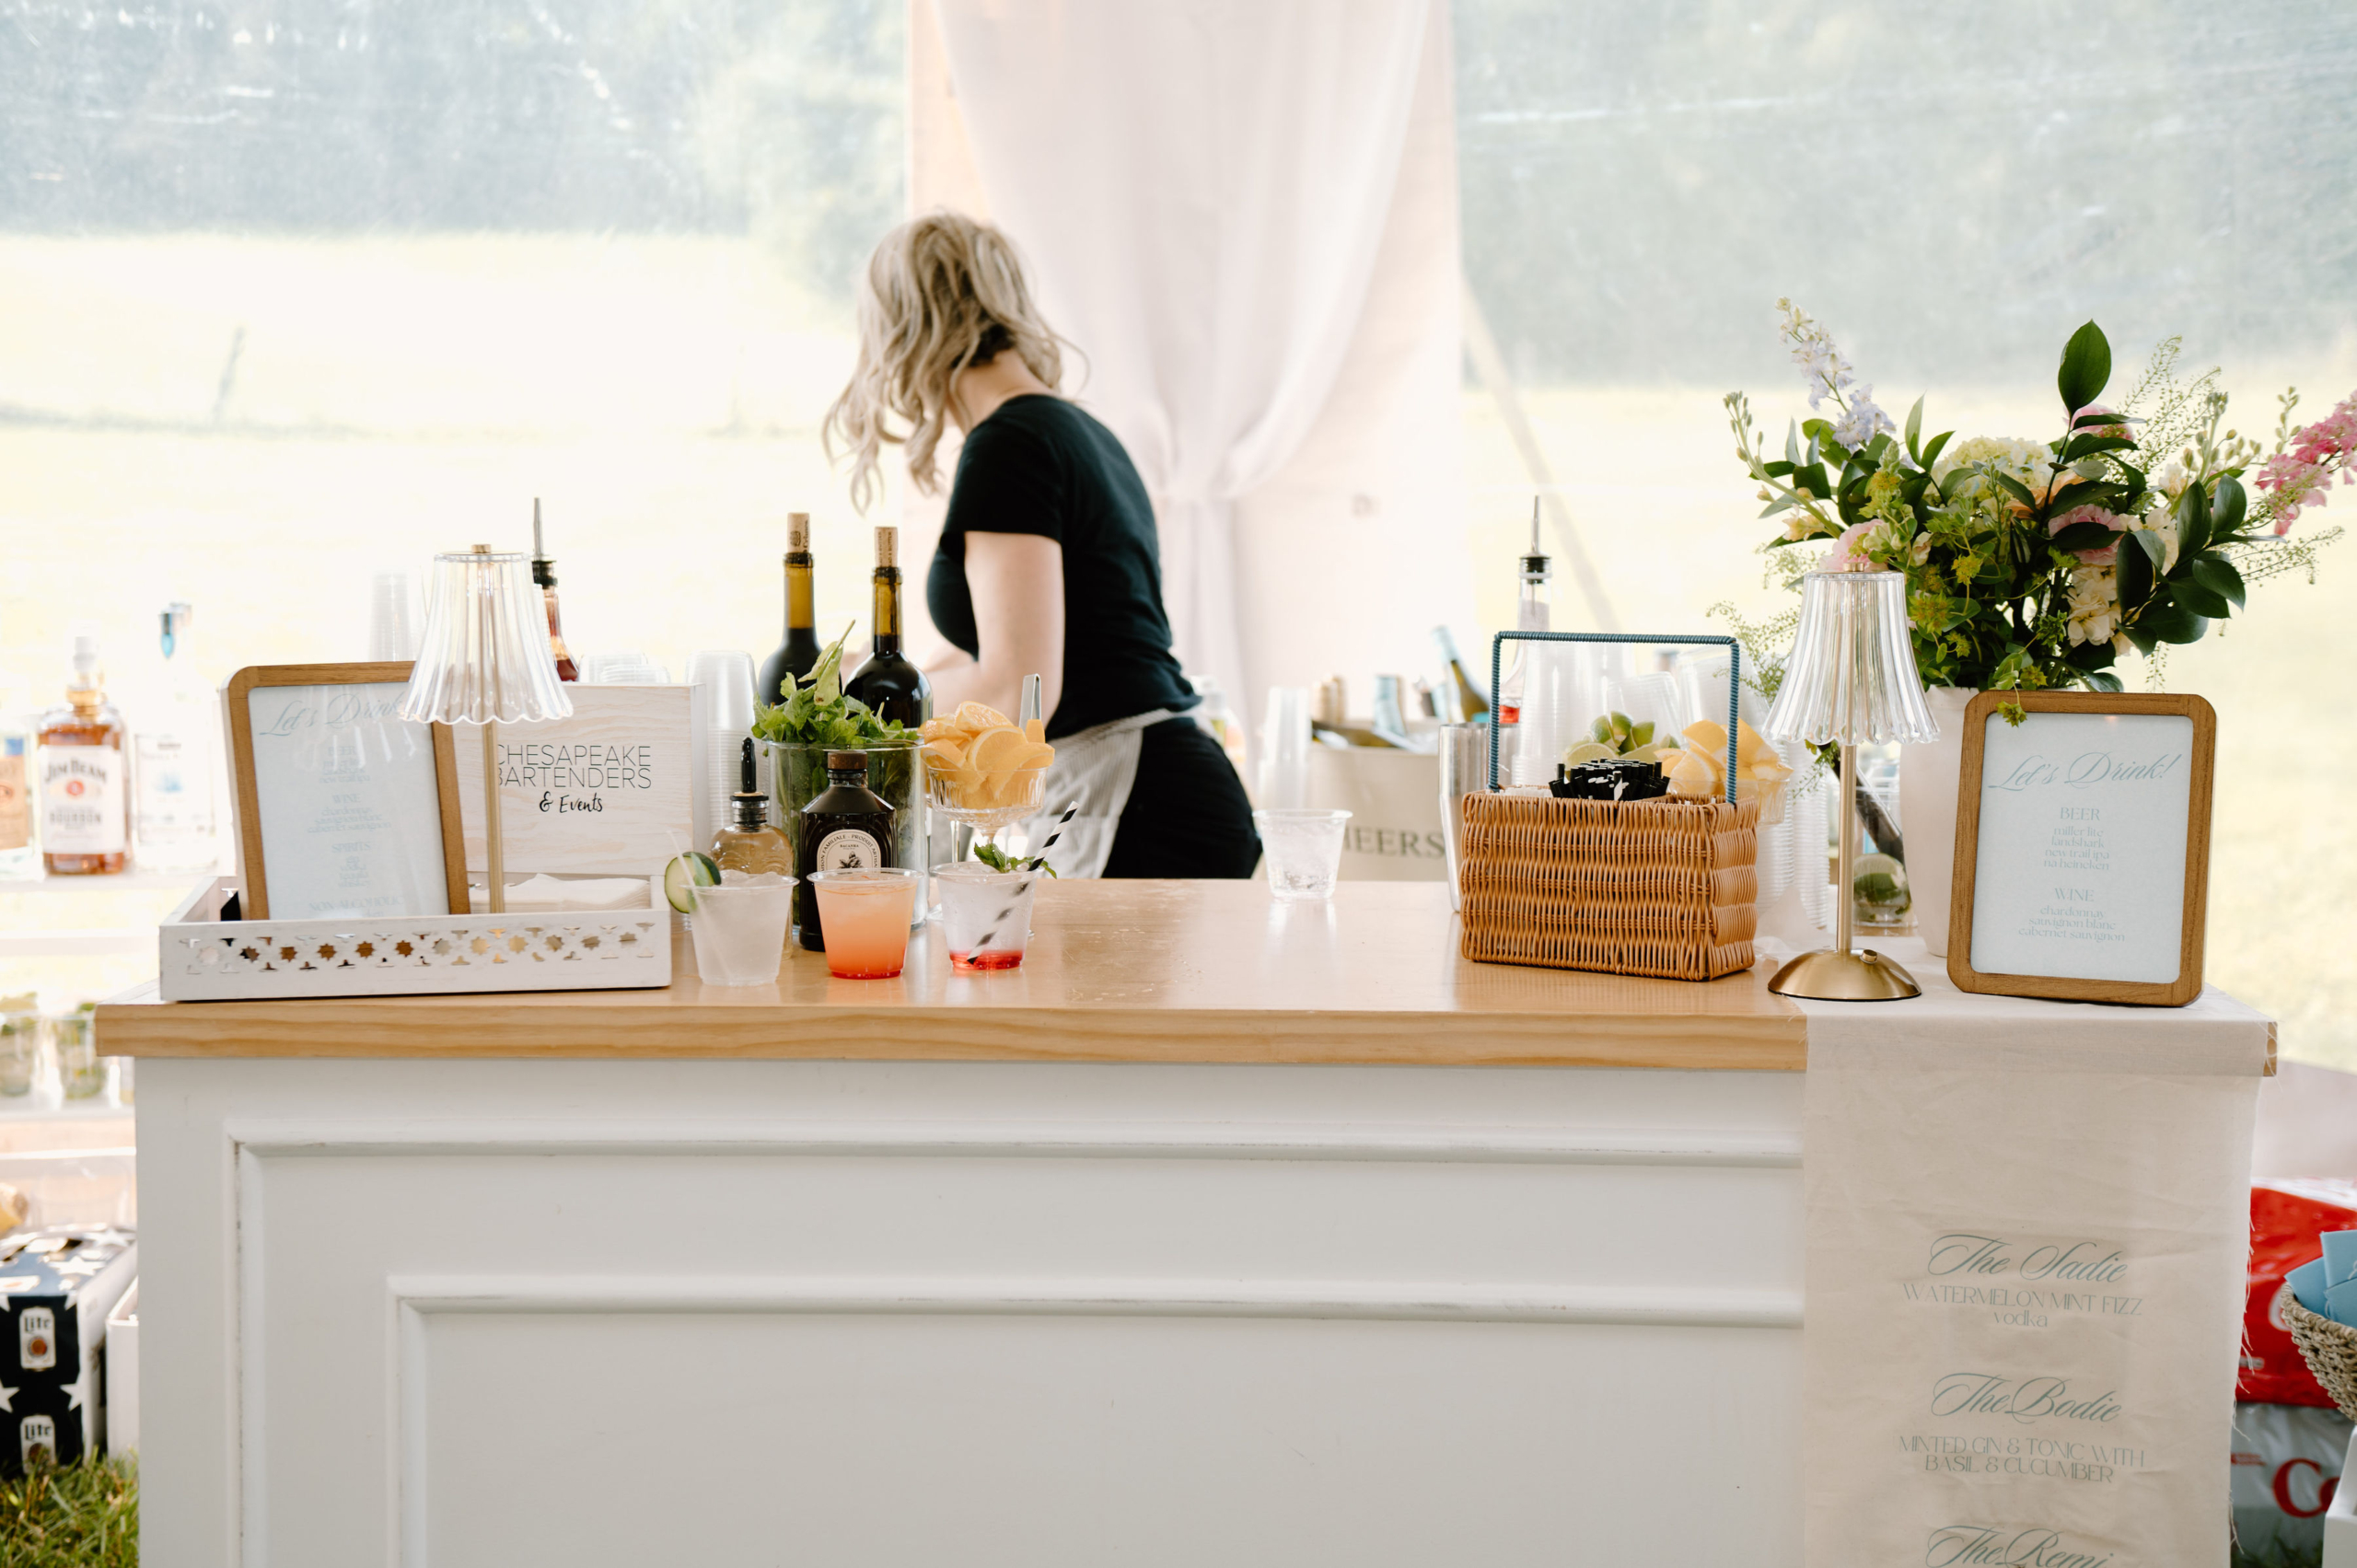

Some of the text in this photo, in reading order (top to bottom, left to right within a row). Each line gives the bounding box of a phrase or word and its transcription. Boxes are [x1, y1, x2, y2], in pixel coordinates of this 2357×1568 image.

[259, 691, 405, 737] Let's Drink
[45, 761, 67, 783] JIM
[70, 757, 107, 784] BEAM
[1988, 750, 2183, 792] Let's Drink!
[331, 793, 361, 804] WINE
[539, 790, 603, 813] & Events
[2060, 807, 2100, 821] BEER
[2054, 826, 2104, 837] miller lite
[822, 834, 846, 854] FAMILIALE
[851, 834, 874, 848] PRODUIT
[1344, 826, 1446, 861] EERS
[2051, 835, 2105, 848] landshark
[2044, 858, 2109, 870] na heineken
[2045, 848, 2109, 862] new trail ipa
[2054, 888, 2095, 902] WINE
[2040, 905, 2106, 921] chardonnay
[2029, 917, 2117, 931] sauvignon blanc
[2018, 926, 2125, 943] cabernet sauvignon
[1928, 1234, 2129, 1283] The Sadie
[1903, 1283, 2142, 1317] WATERMELON MINT FIZZ
[24, 1316, 51, 1334] Lite
[1993, 1309, 2049, 1328] vodka
[1931, 1372, 2122, 1424] The Bodie
[24, 1423, 51, 1442] Lite
[1898, 1435, 2144, 1468] MINTED GIN & TONIC WITH
[1925, 1455, 2114, 1483] BASIL & CUCUMBER
[1926, 1526, 2007, 1568] The
